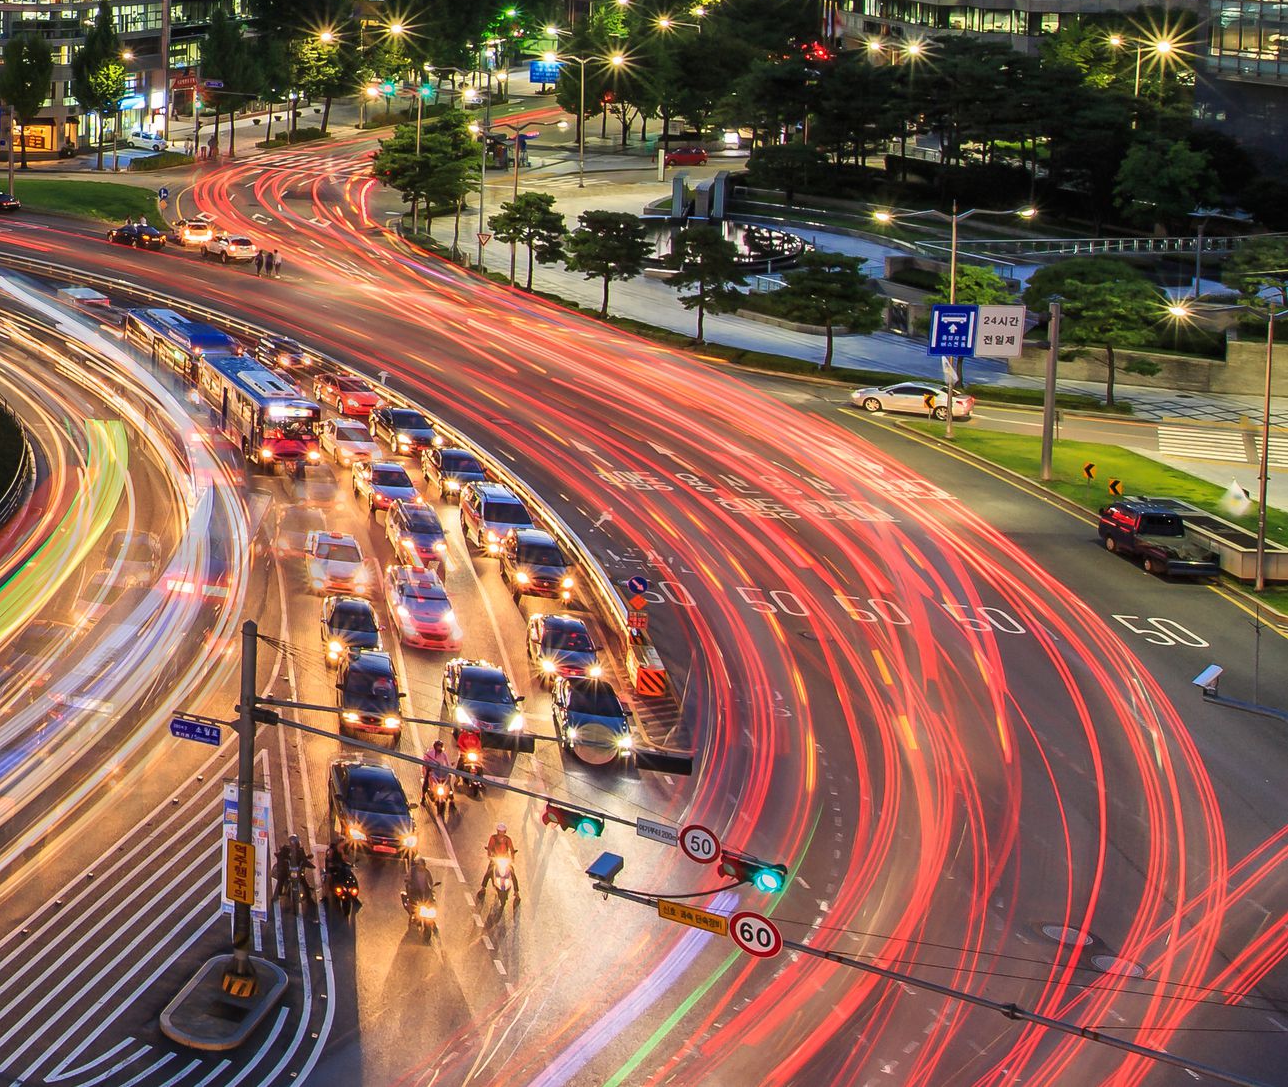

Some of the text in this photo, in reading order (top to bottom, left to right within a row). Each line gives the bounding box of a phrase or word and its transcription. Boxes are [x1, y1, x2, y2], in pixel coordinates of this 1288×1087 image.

[983, 316, 1019, 326] 24시간
[983, 335, 1015, 346] 전일제
[735, 586, 810, 616] 50
[833, 594, 912, 626] 50
[940, 603, 1027, 634] 50
[1111, 614, 1210, 647] 50
[690, 836, 712, 855] 50
[740, 922, 771, 948] 60
